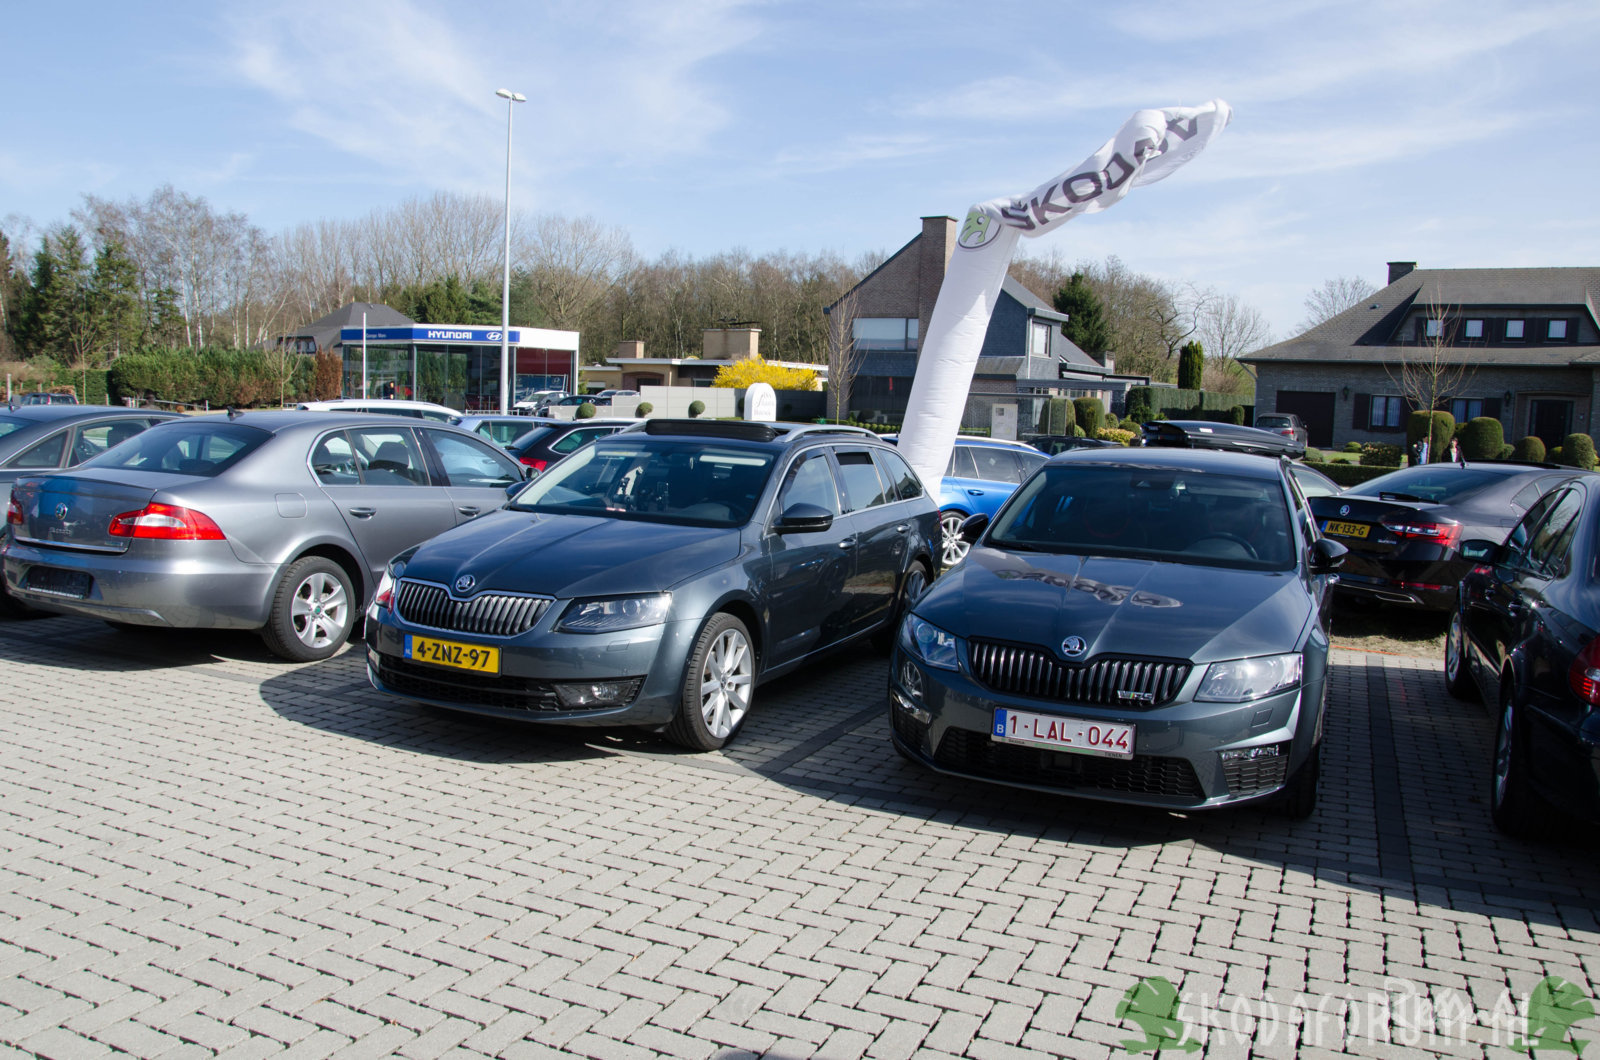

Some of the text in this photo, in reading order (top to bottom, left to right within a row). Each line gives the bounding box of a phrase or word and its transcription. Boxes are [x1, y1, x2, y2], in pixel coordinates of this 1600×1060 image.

[428, 330, 472, 339] HYUNDAI
[1328, 522, 1365, 536] NK-133-G
[417, 641, 490, 667] 4-ZNZ-97
[996, 724, 1004, 734] B
[1010, 715, 1129, 749] 1-LAL-044
